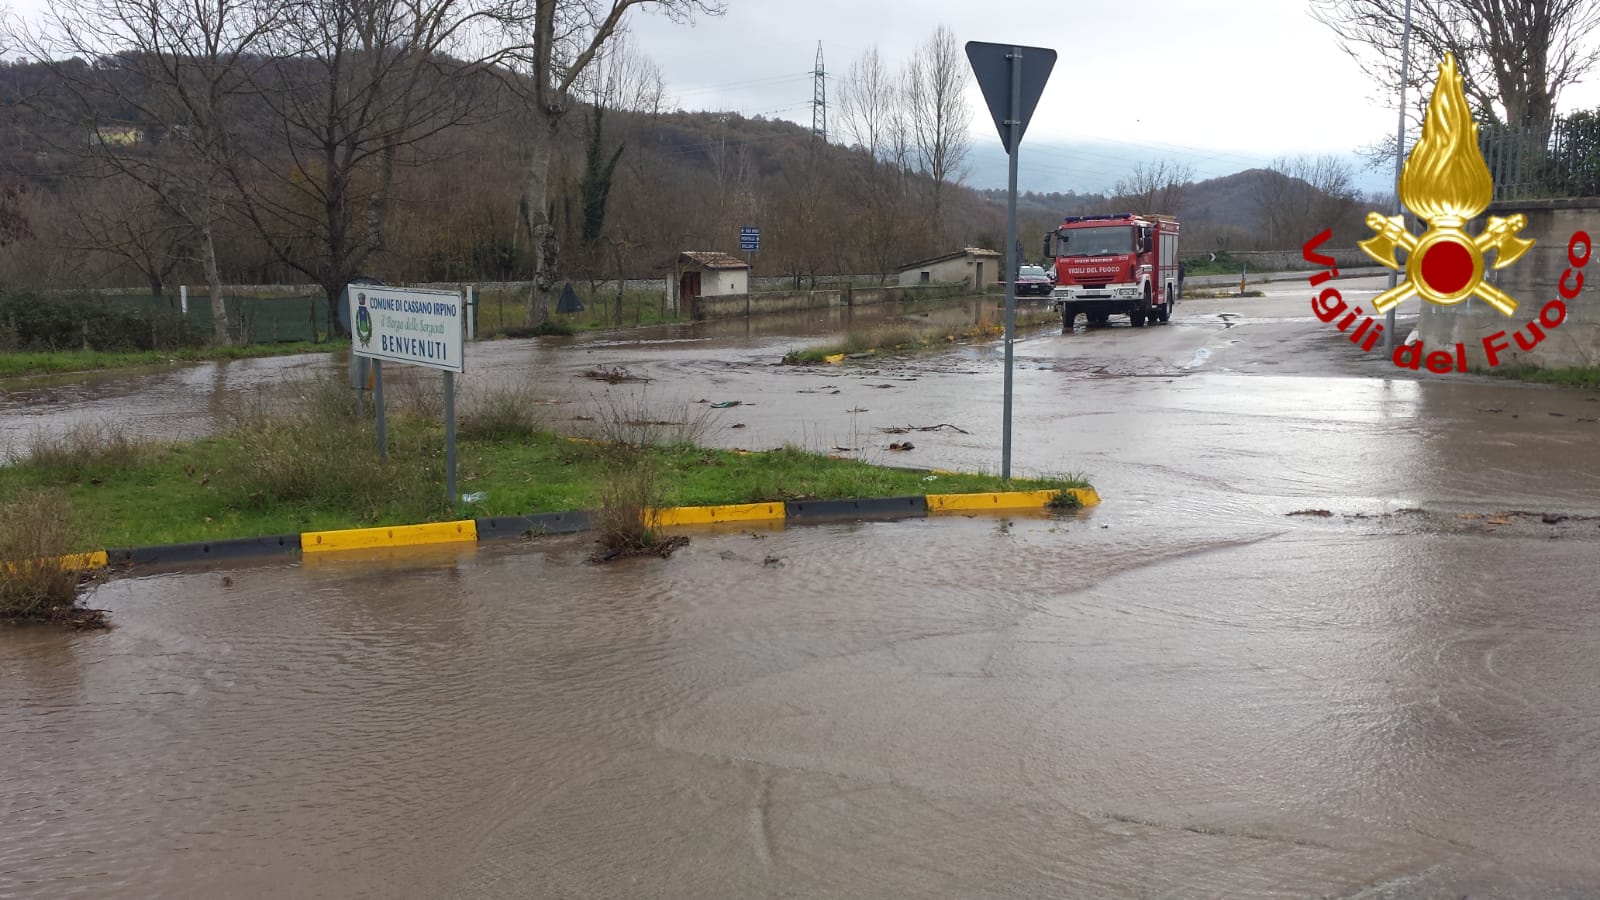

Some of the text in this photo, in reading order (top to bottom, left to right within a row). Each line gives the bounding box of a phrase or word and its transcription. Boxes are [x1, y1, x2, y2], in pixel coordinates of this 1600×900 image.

[370, 297, 457, 317] COMUNE DI CASSANO IRPINO
[381, 334, 447, 360] BENVENUTI
